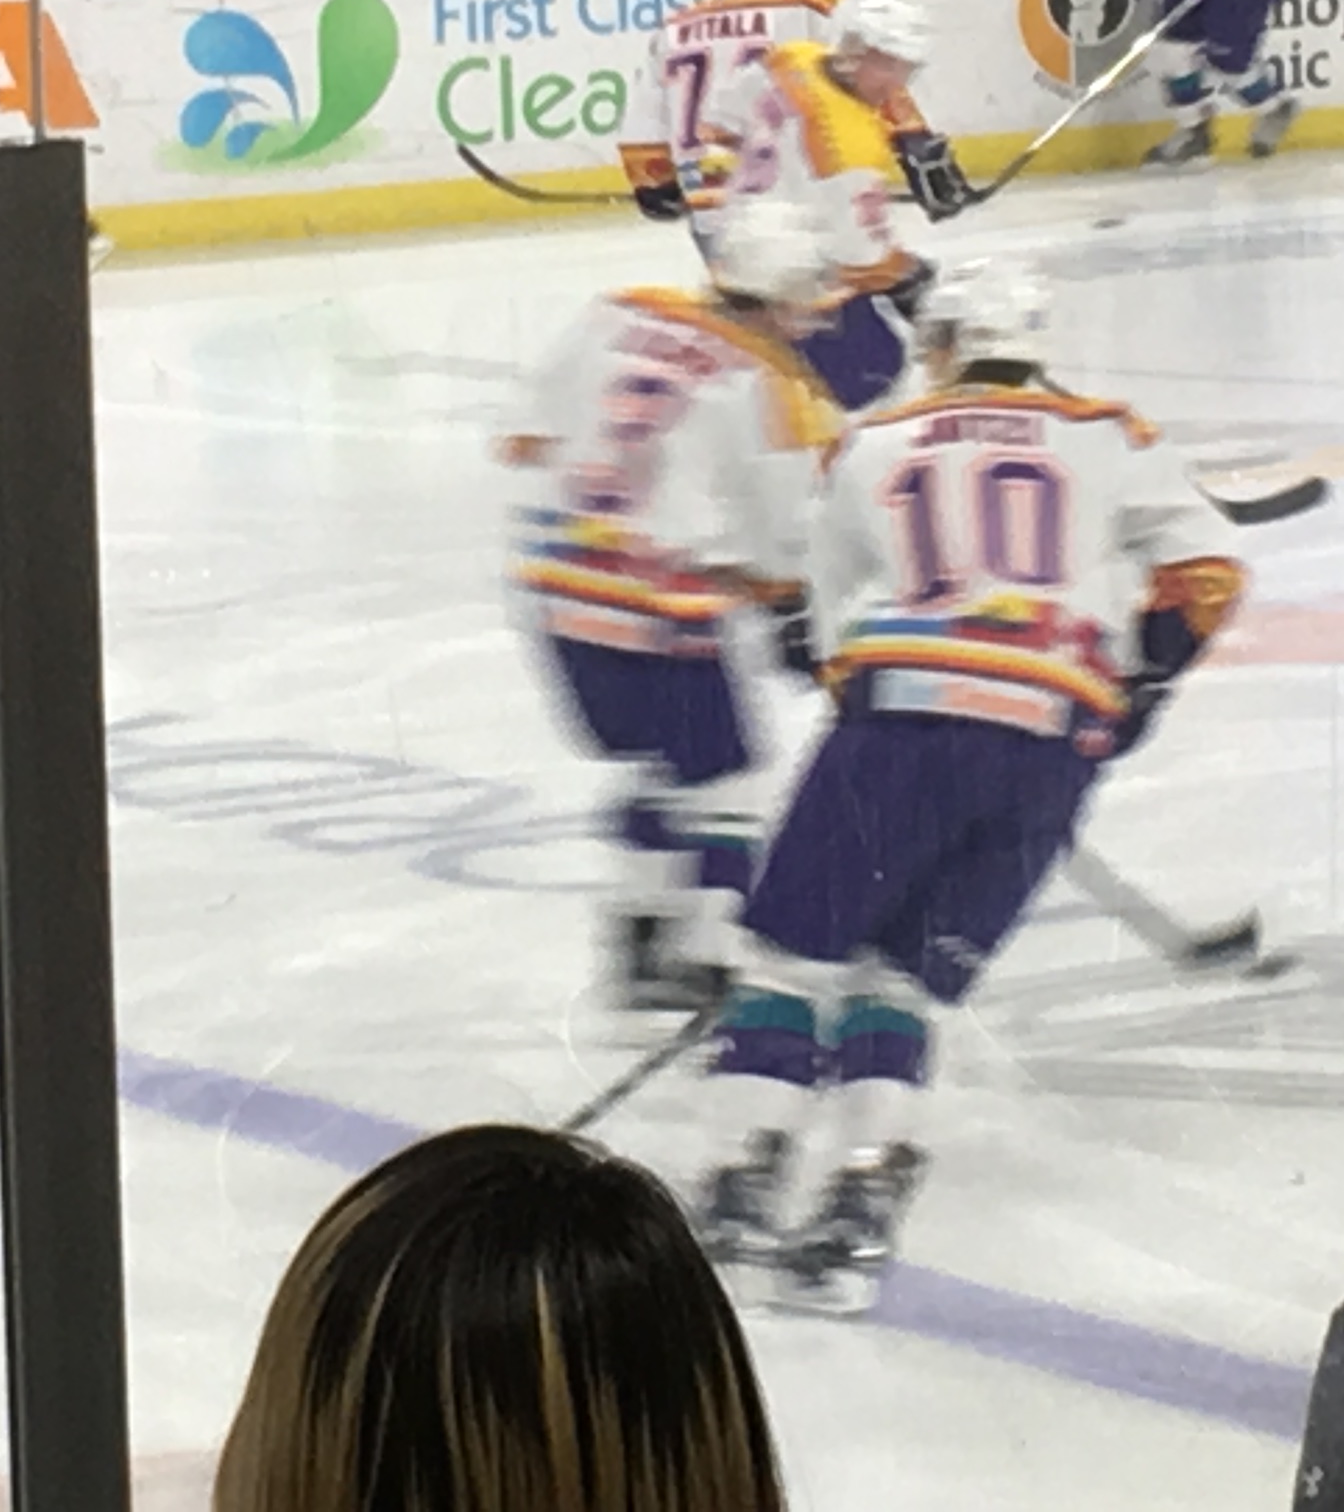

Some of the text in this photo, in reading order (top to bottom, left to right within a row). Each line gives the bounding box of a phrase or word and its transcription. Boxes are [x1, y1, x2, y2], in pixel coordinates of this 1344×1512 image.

[436, 54, 642, 146] Clea
[1268, 39, 1331, 90] nic
[878, 450, 1074, 612] 10
